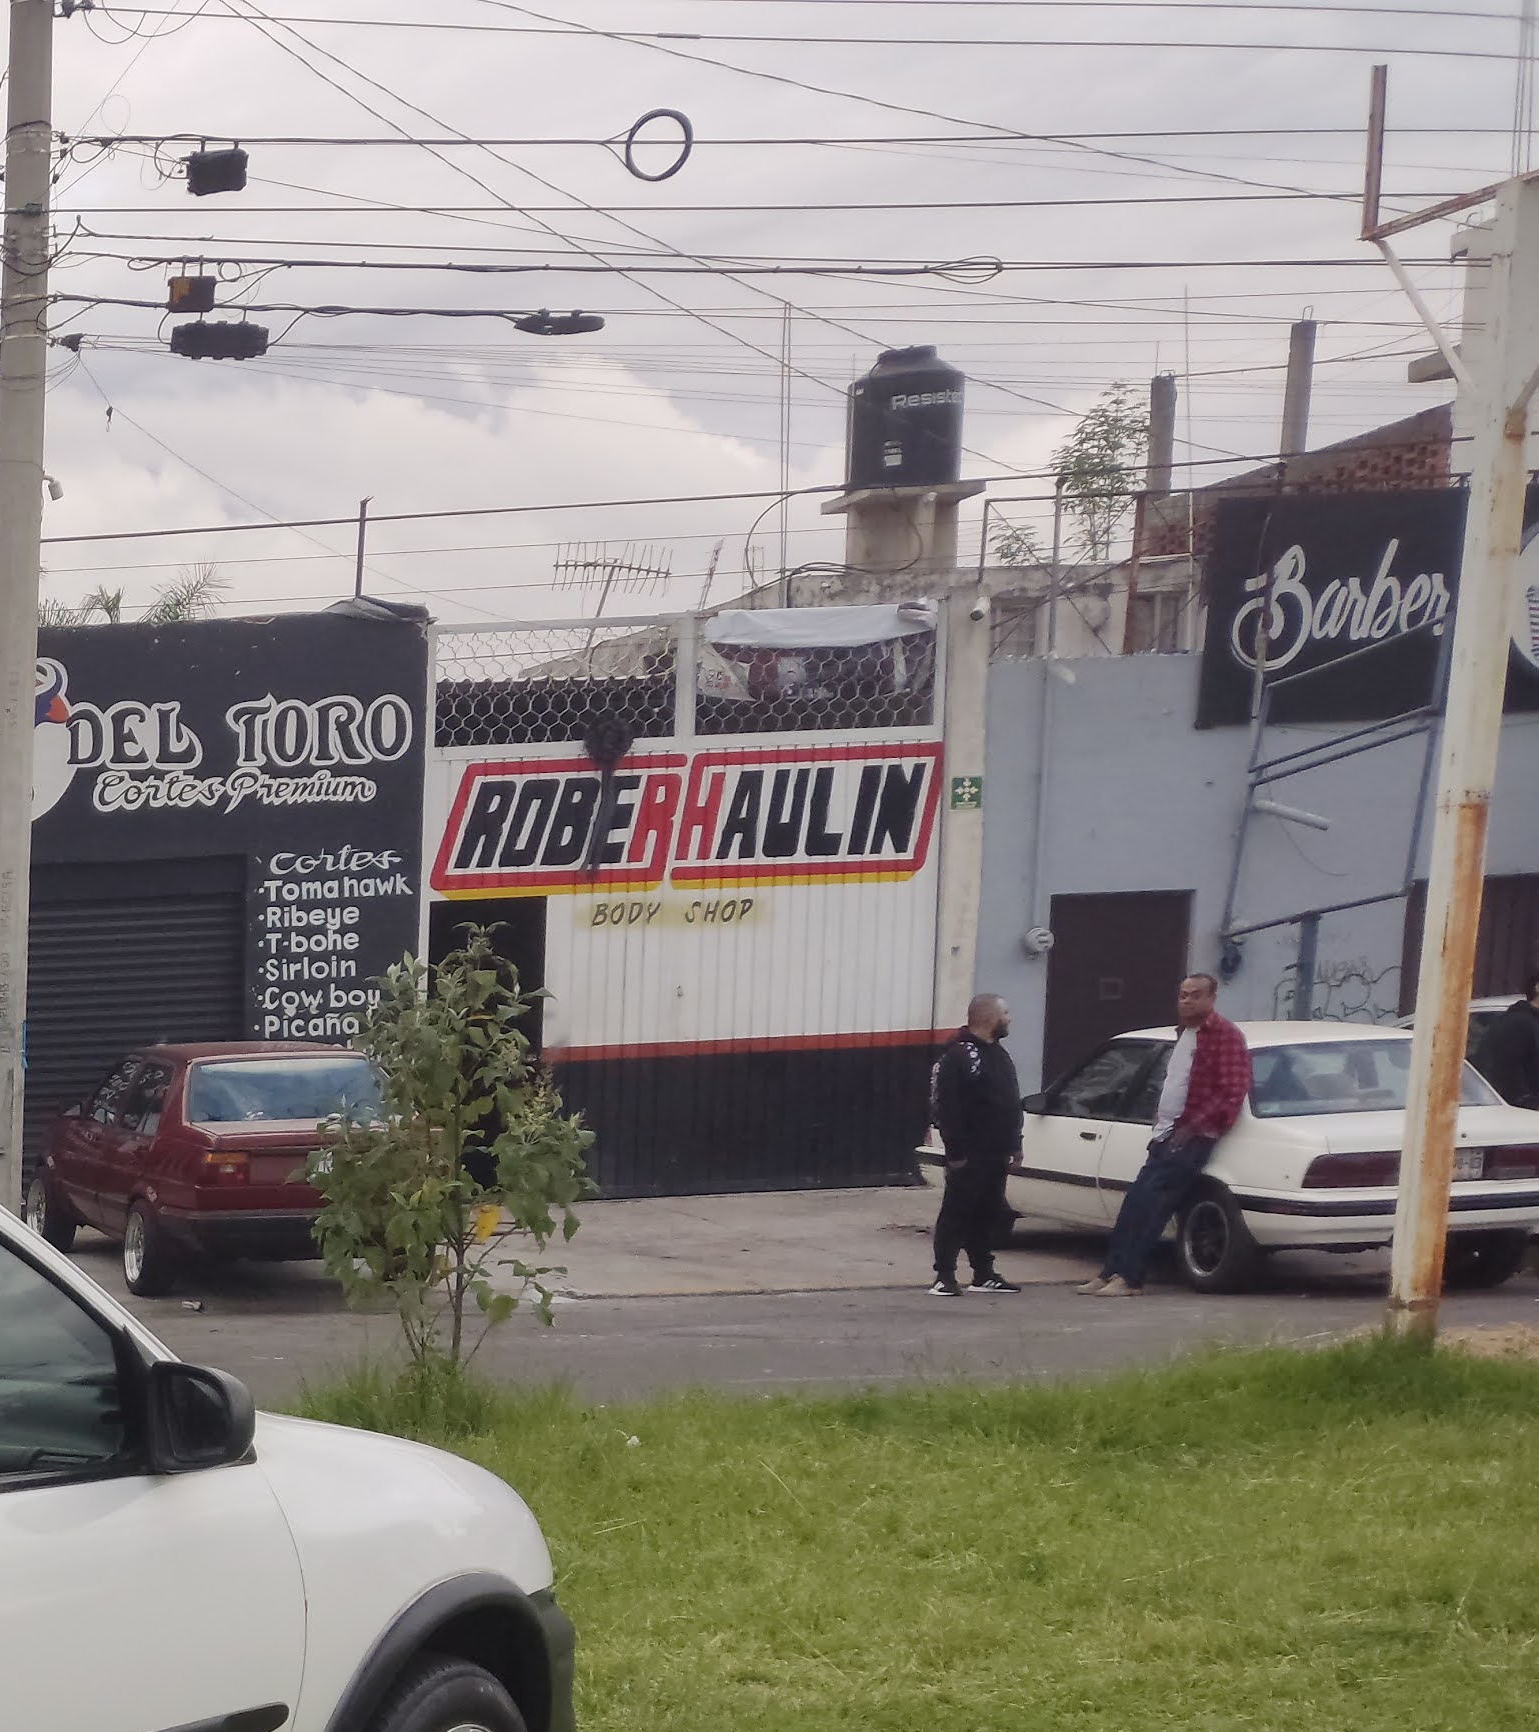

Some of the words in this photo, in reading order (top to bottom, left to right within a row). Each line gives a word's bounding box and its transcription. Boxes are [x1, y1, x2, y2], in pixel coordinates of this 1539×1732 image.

[1232, 538, 1450, 671] Barber
[67, 701, 202, 769] DEL
[226, 692, 412, 766] TORO
[93, 771, 223, 812] Cortes
[224, 767, 377, 814] Premium
[676, 763, 927, 861] HAULIN
[271, 844, 403, 875] Cortes
[264, 873, 414, 901] Tomahawk
[266, 904, 360, 930] Ribeye
[591, 902, 661, 927] BODY
[685, 898, 754, 923] SHOP
[265, 956, 357, 981] Sirloin
[264, 1012, 360, 1039] Picaña
